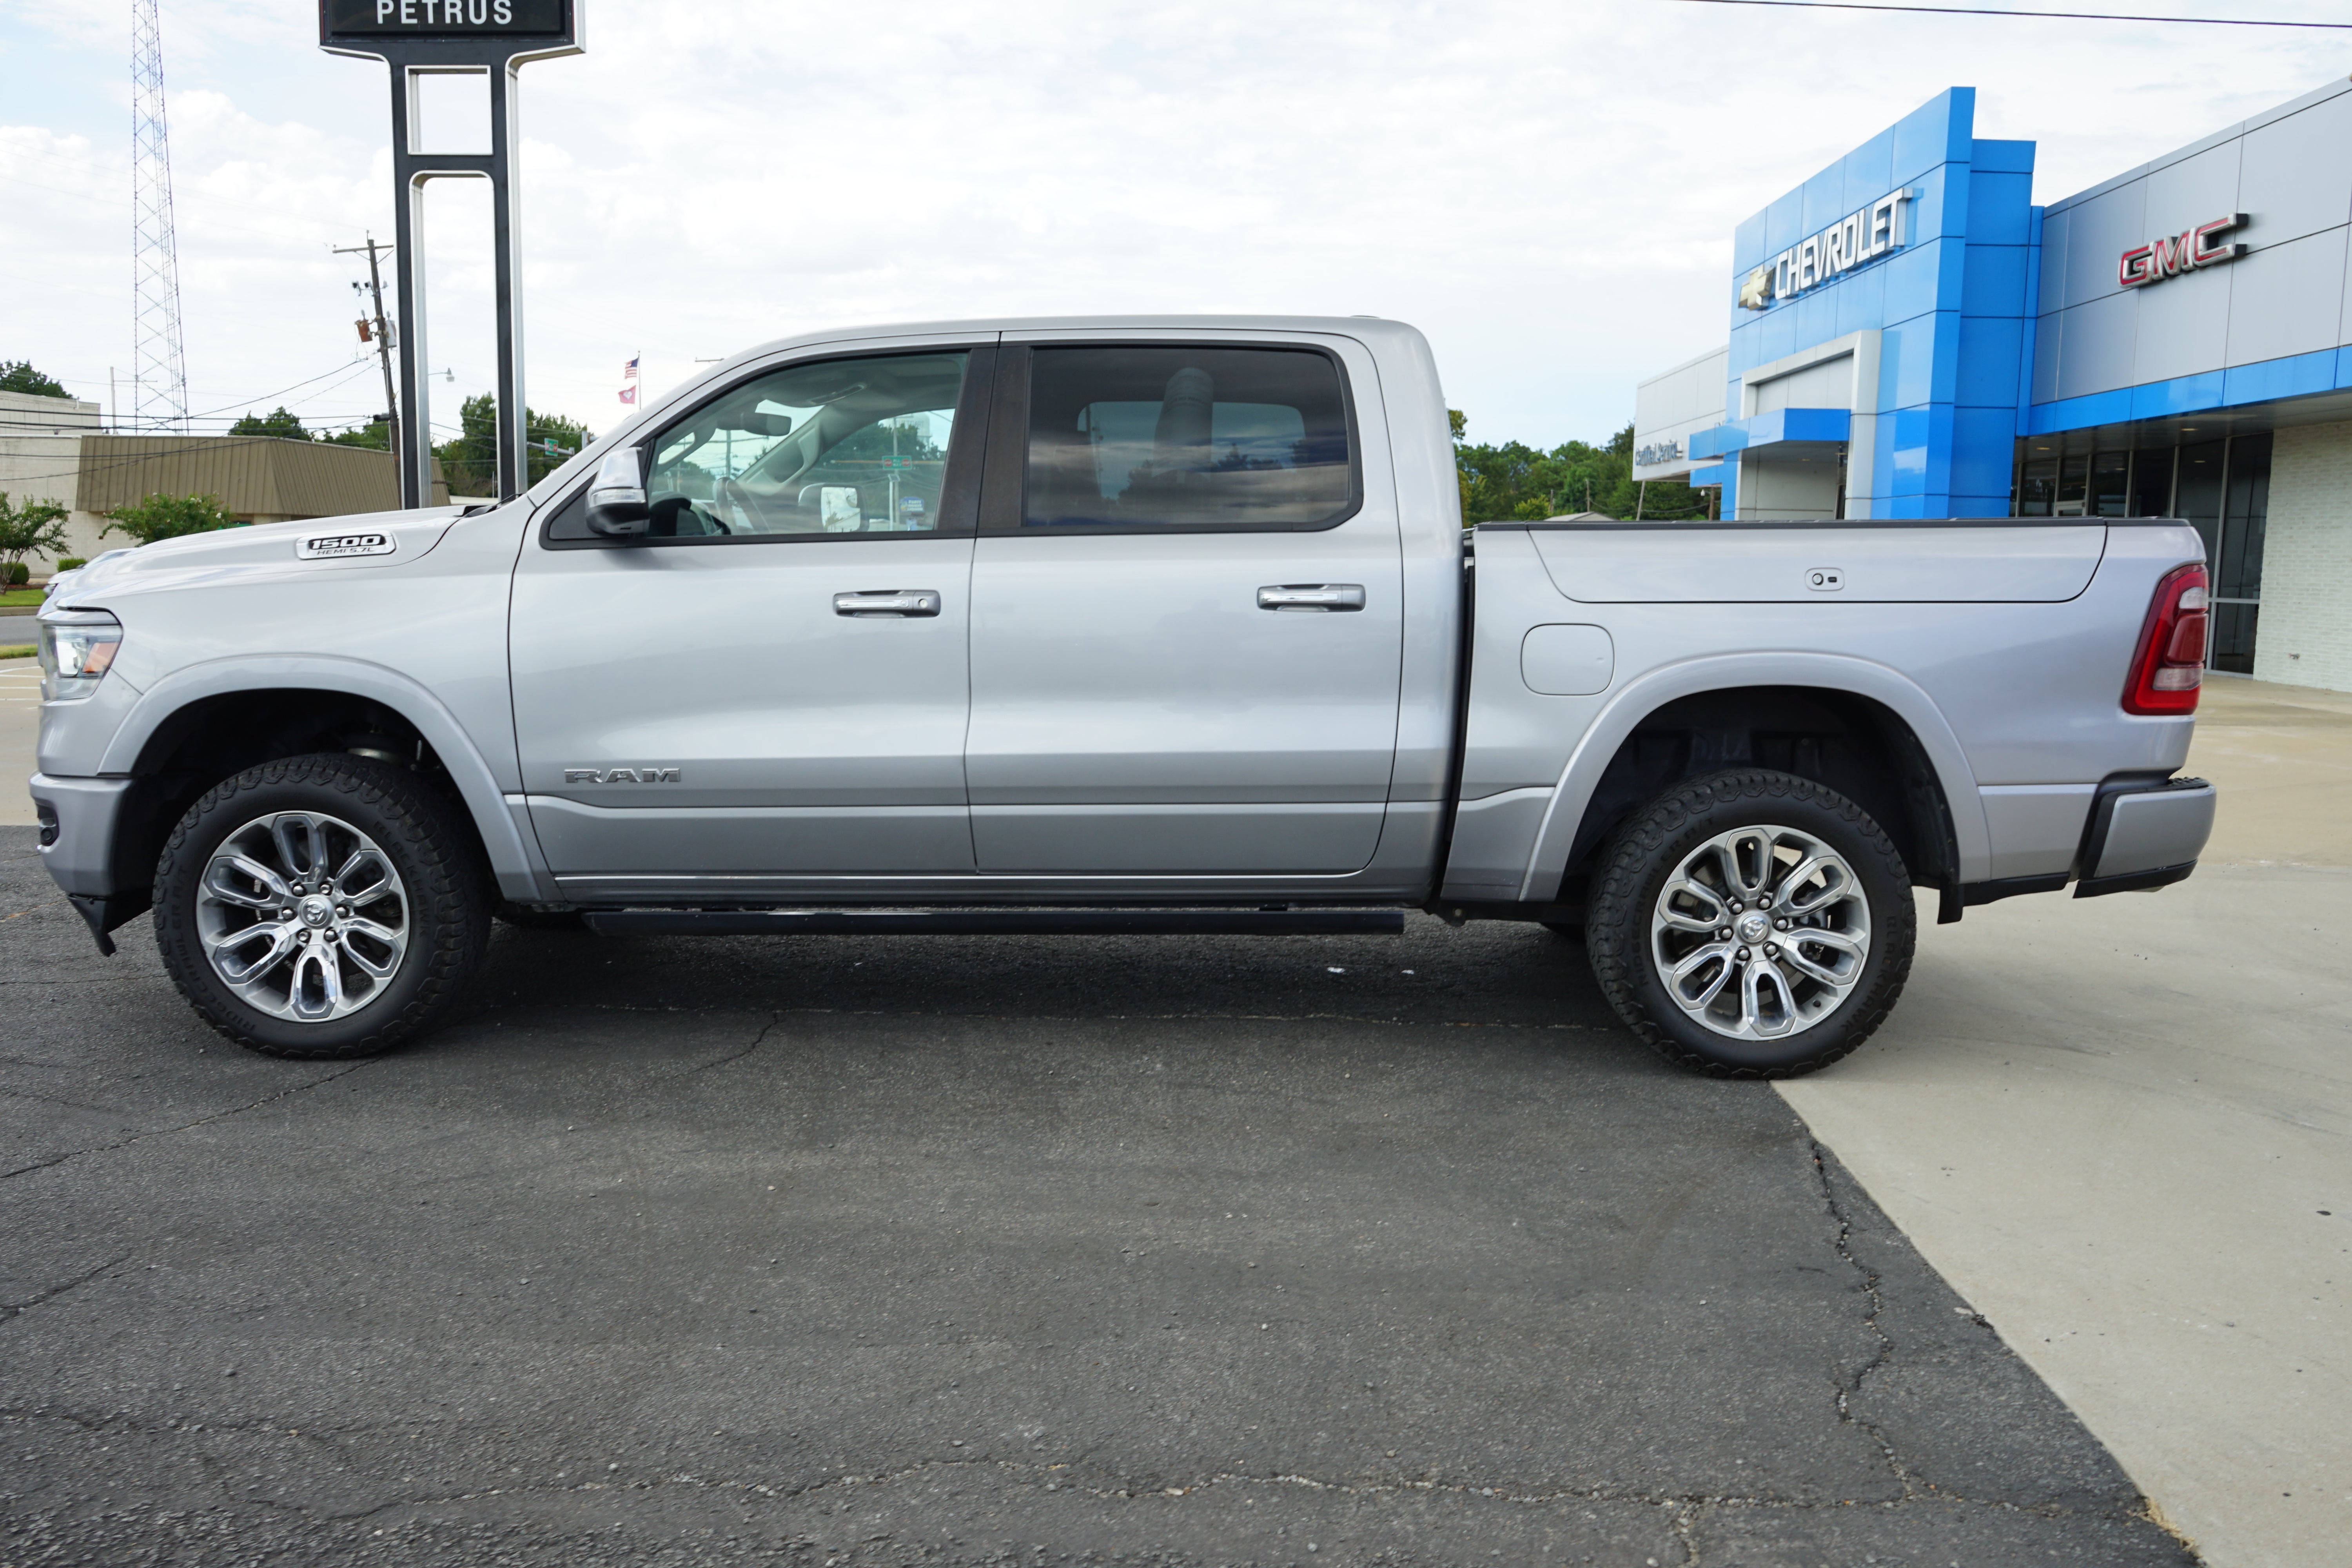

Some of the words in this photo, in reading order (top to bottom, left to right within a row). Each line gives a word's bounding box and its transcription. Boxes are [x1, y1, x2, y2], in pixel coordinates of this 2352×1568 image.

[377, 0, 512, 24] PETRUS
[1775, 187, 1911, 300] CHEVROLET
[2118, 213, 2239, 288] GMC
[312, 535, 381, 549] 1500
[564, 768, 681, 783] RAM
[372, 820, 429, 939] BLACKHAWK
[1841, 916, 1896, 1033] BLACKHAWK
